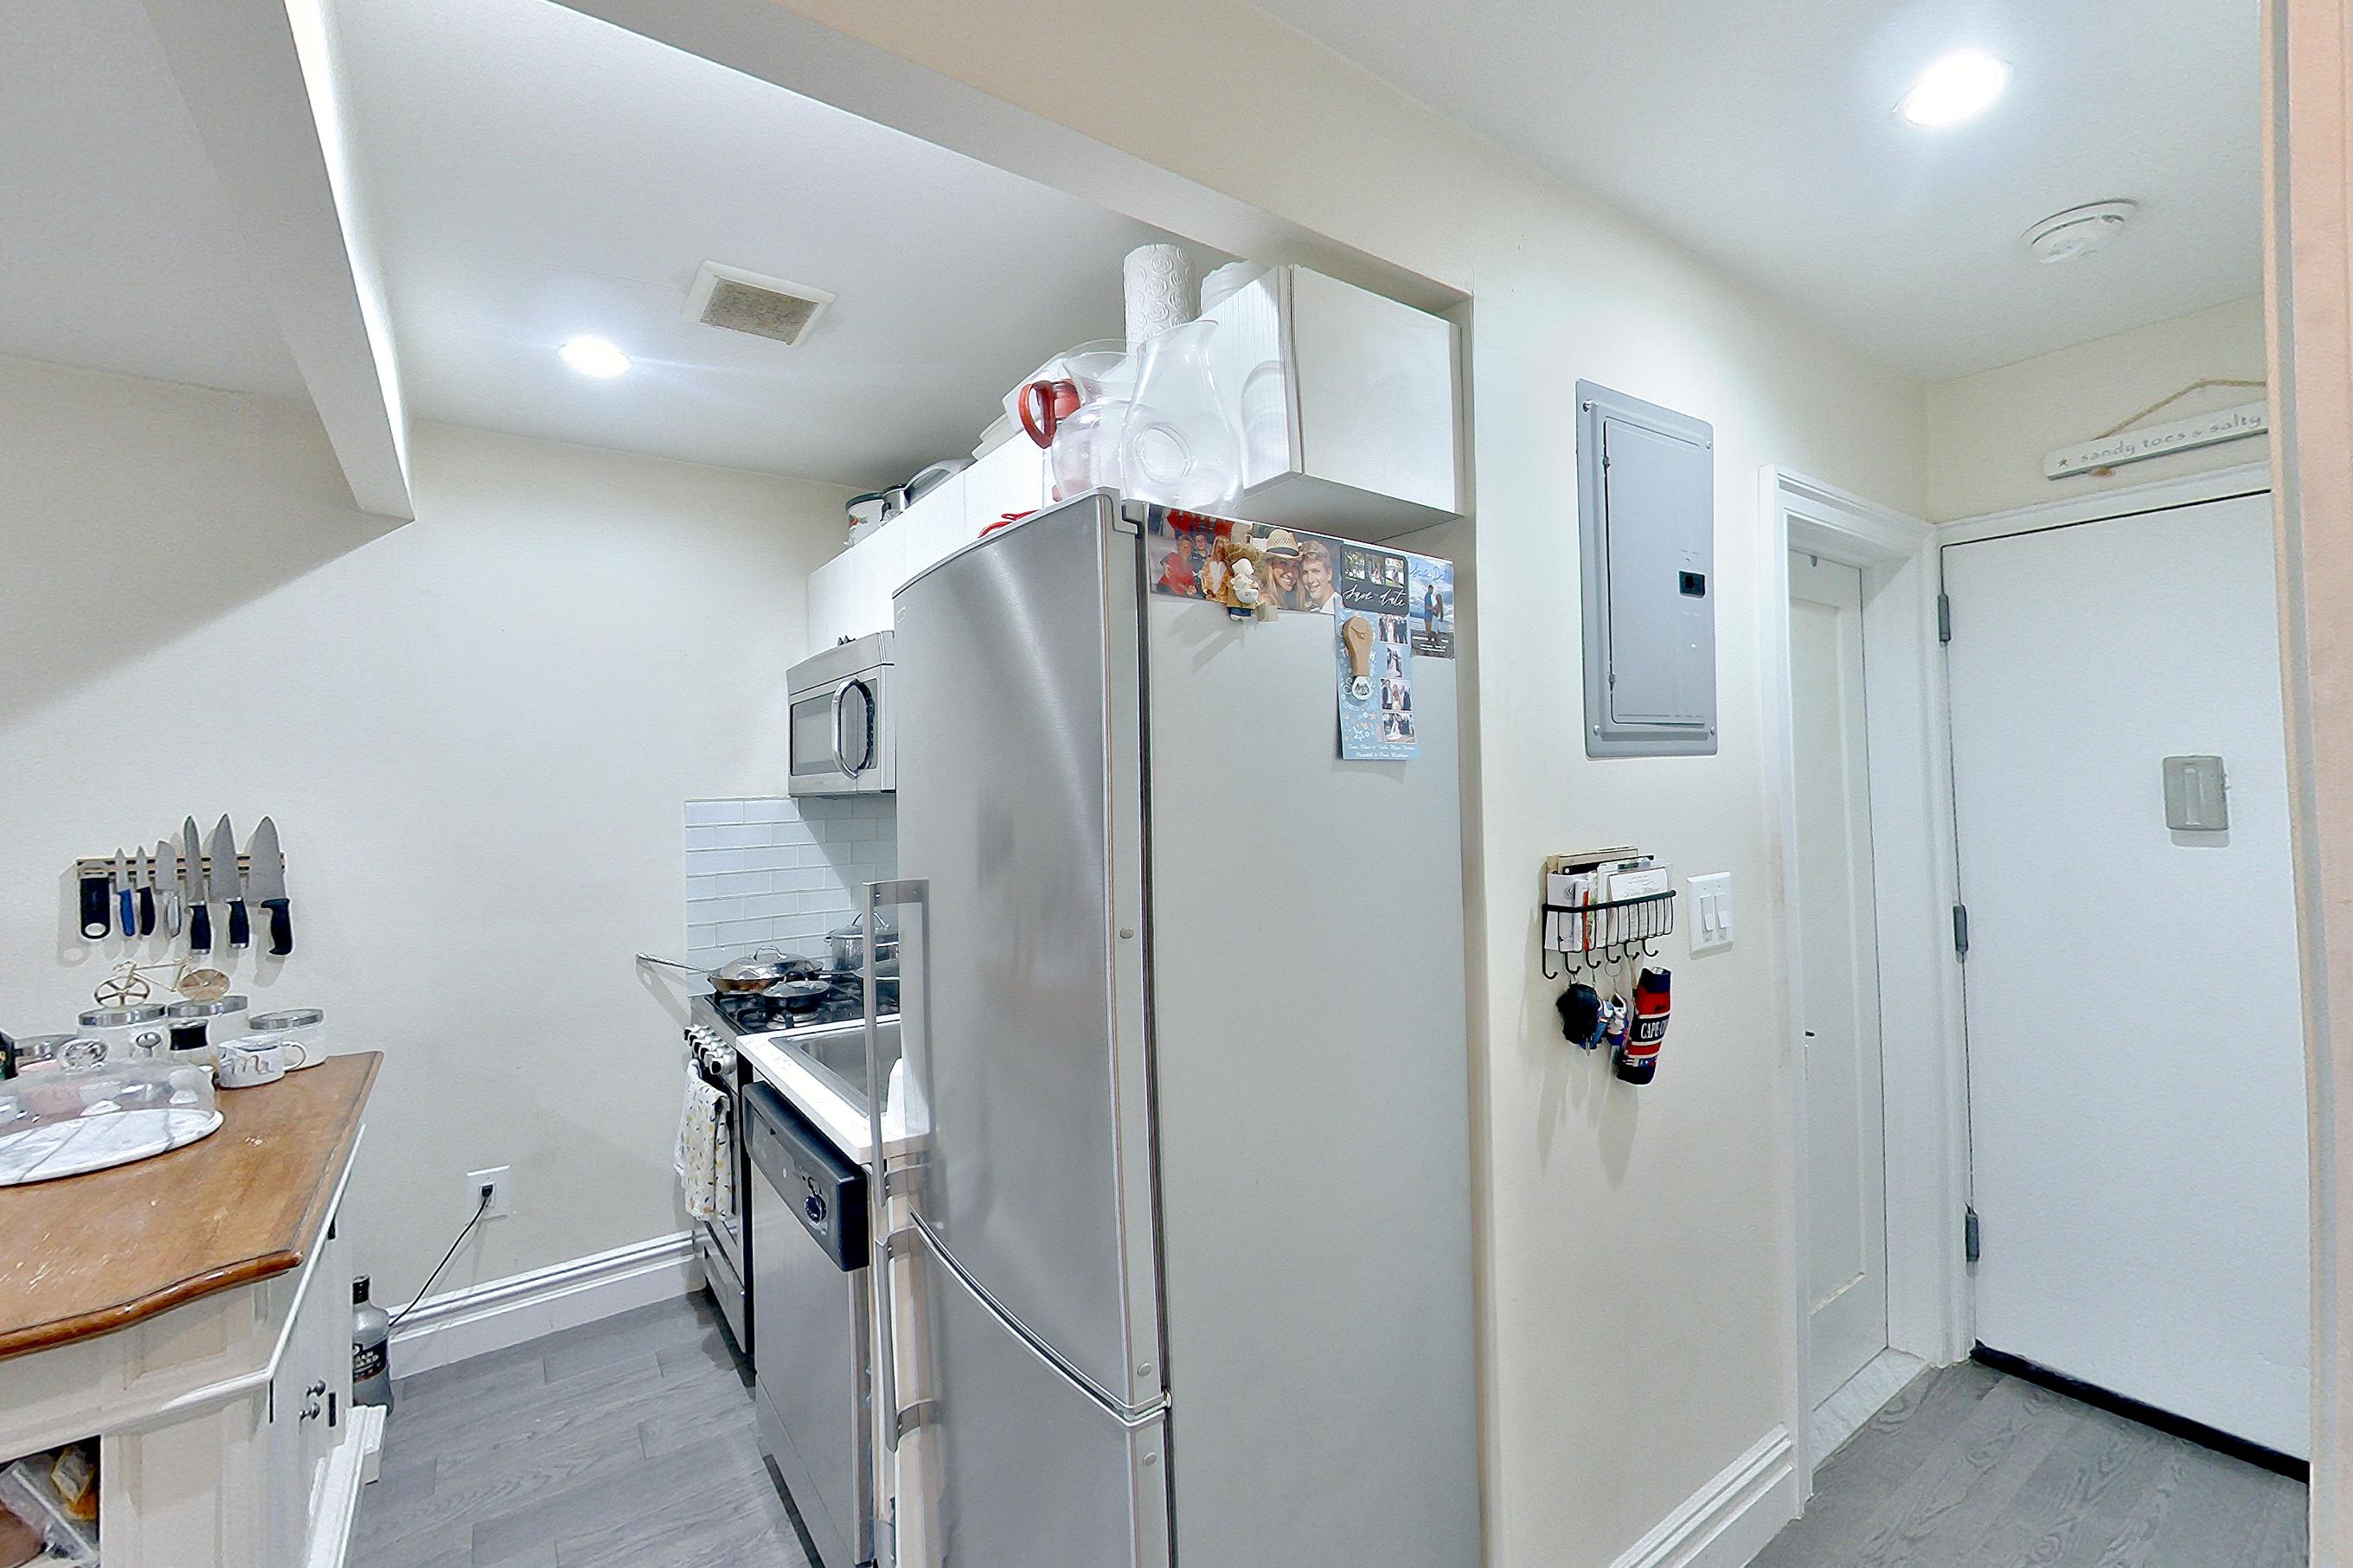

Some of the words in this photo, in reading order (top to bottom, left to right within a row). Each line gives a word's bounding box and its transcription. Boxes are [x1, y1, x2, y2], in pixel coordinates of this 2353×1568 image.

[2081, 440, 2137, 463] sandy
[2142, 432, 2186, 447] toes
[2210, 413, 2261, 432] salty
[1641, 1022, 1660, 1039] CAPE
